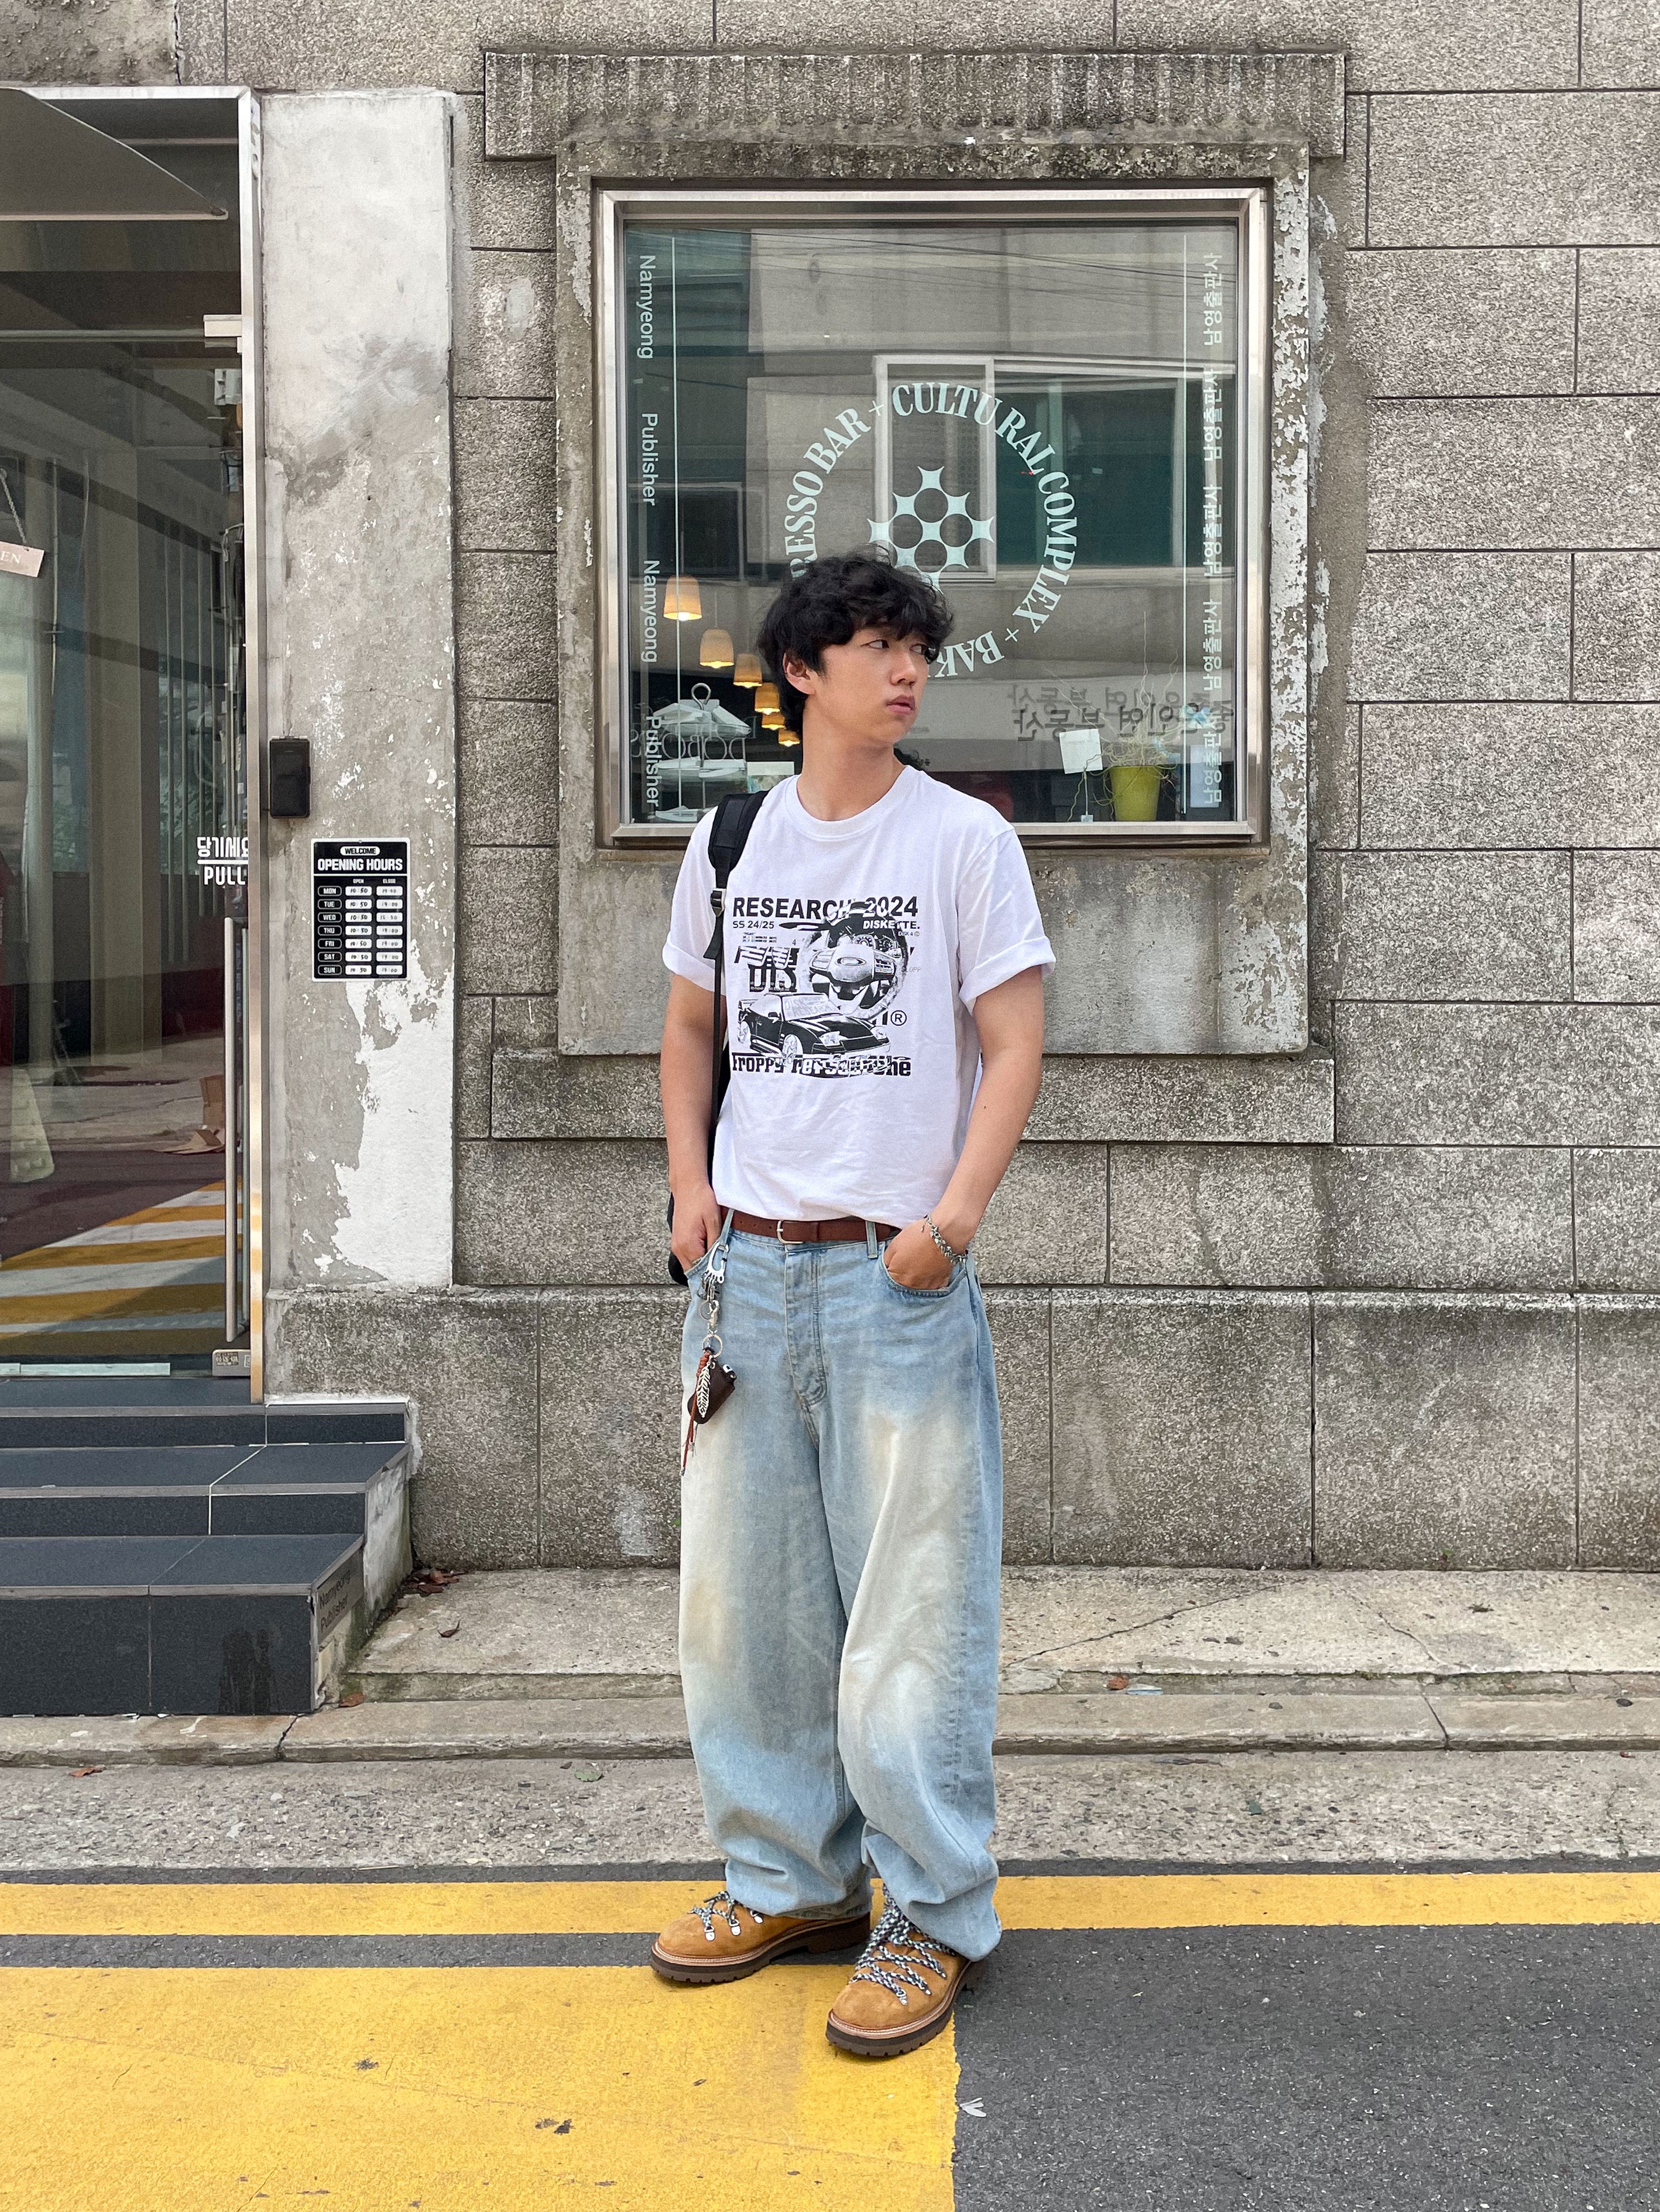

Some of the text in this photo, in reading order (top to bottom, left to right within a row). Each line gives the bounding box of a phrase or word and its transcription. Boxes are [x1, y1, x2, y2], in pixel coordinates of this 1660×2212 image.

[1203, 253, 1223, 346] 남영출판사
[803, 408, 871, 474] BAR
[892, 382, 1055, 475] CULTURAL
[1203, 369, 1223, 462] 남영출판사
[637, 255, 663, 808] Namyeong Publisher Namyeong Publisher
[784, 470, 824, 579] RESSO
[1012, 470, 1078, 633] COMPLEX
[1203, 485, 1223, 578] 남영출판사
[934, 630, 1005, 678] BAK
[1203, 599, 1223, 691] 남영출판사
[204, 866, 246, 885] PULL
[317, 858, 403, 871] OPENING HOURS
[732, 896, 918, 922] RESEARCH 2024
[732, 920, 774, 929] SS 24/25
